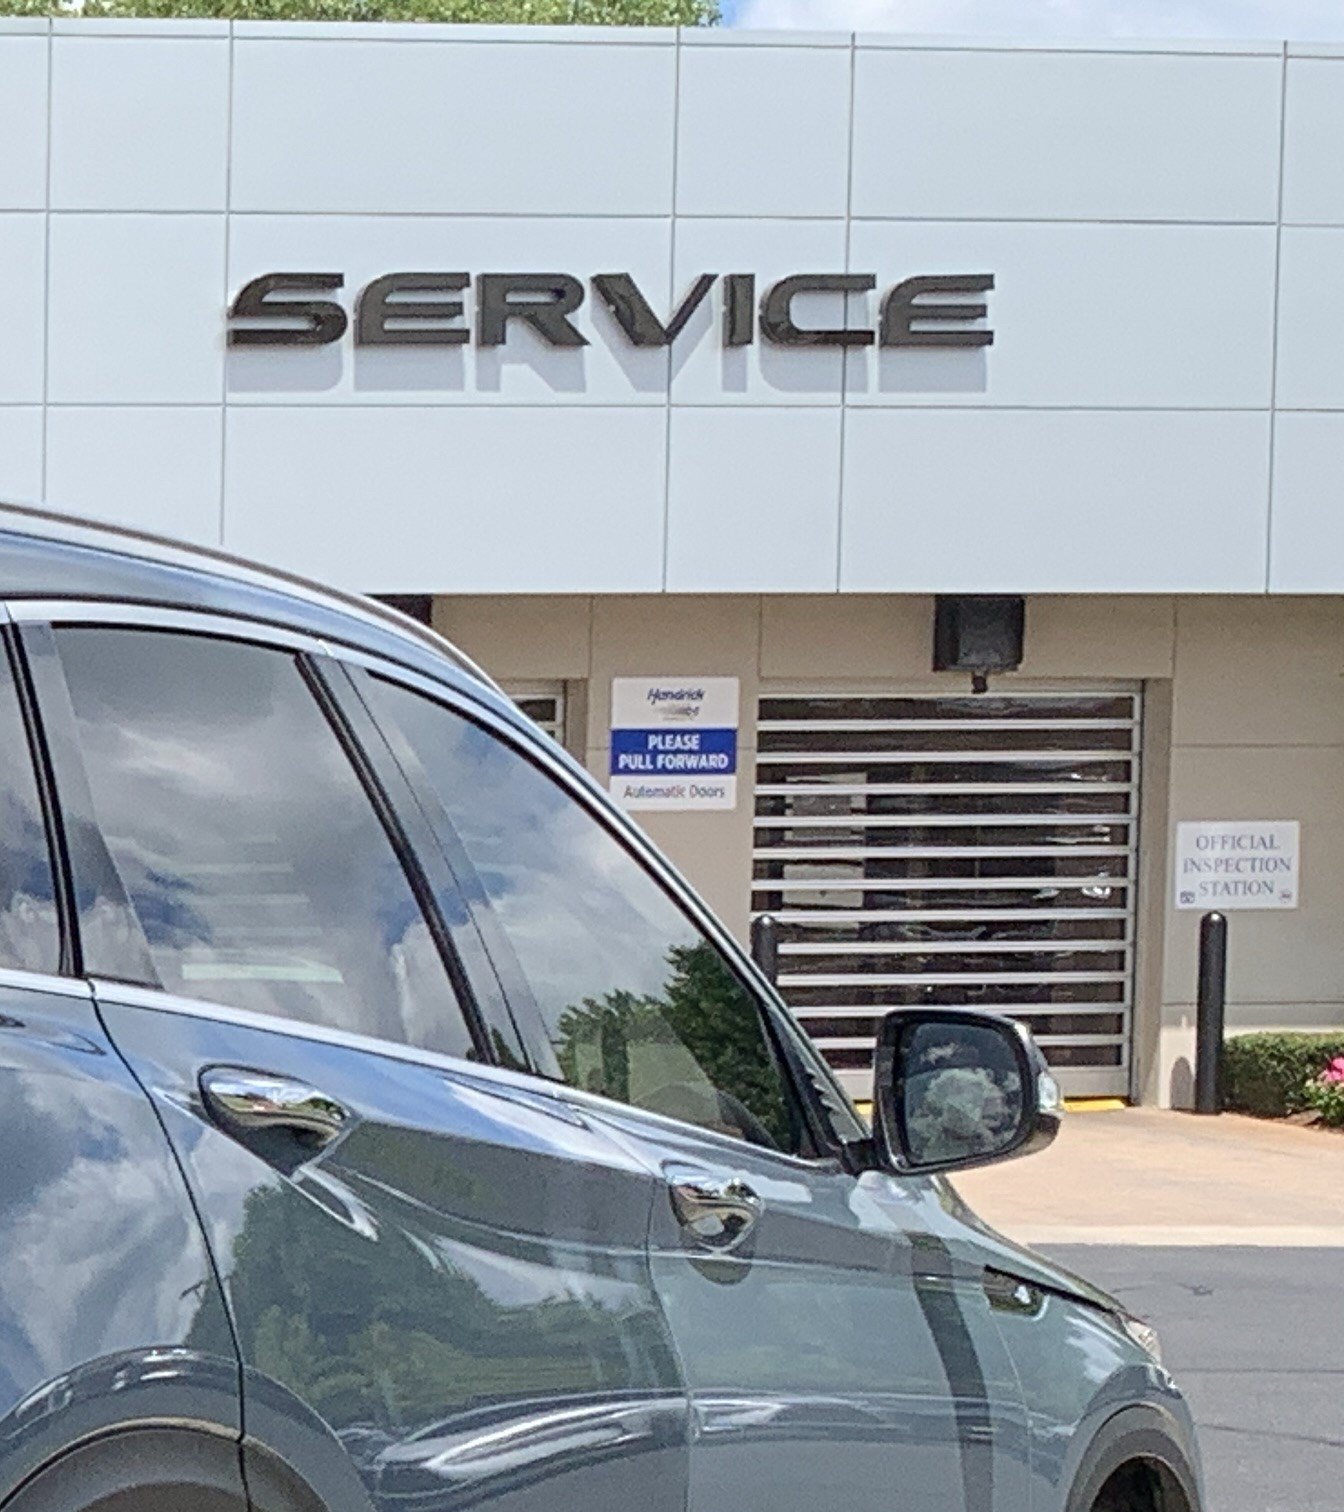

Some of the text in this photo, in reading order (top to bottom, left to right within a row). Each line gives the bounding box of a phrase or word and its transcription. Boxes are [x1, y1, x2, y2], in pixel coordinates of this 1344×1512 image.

[226, 271, 994, 346] SERVICE
[647, 688, 705, 705] Hendrick
[647, 734, 700, 750] PLEASE
[618, 753, 729, 769] PULL FORWARD
[624, 784, 725, 798] Automatic Doors
[1195, 834, 1280, 851] OFFICIAL
[1183, 856, 1292, 874] INSPECTION
[1199, 880, 1275, 897] STATION
